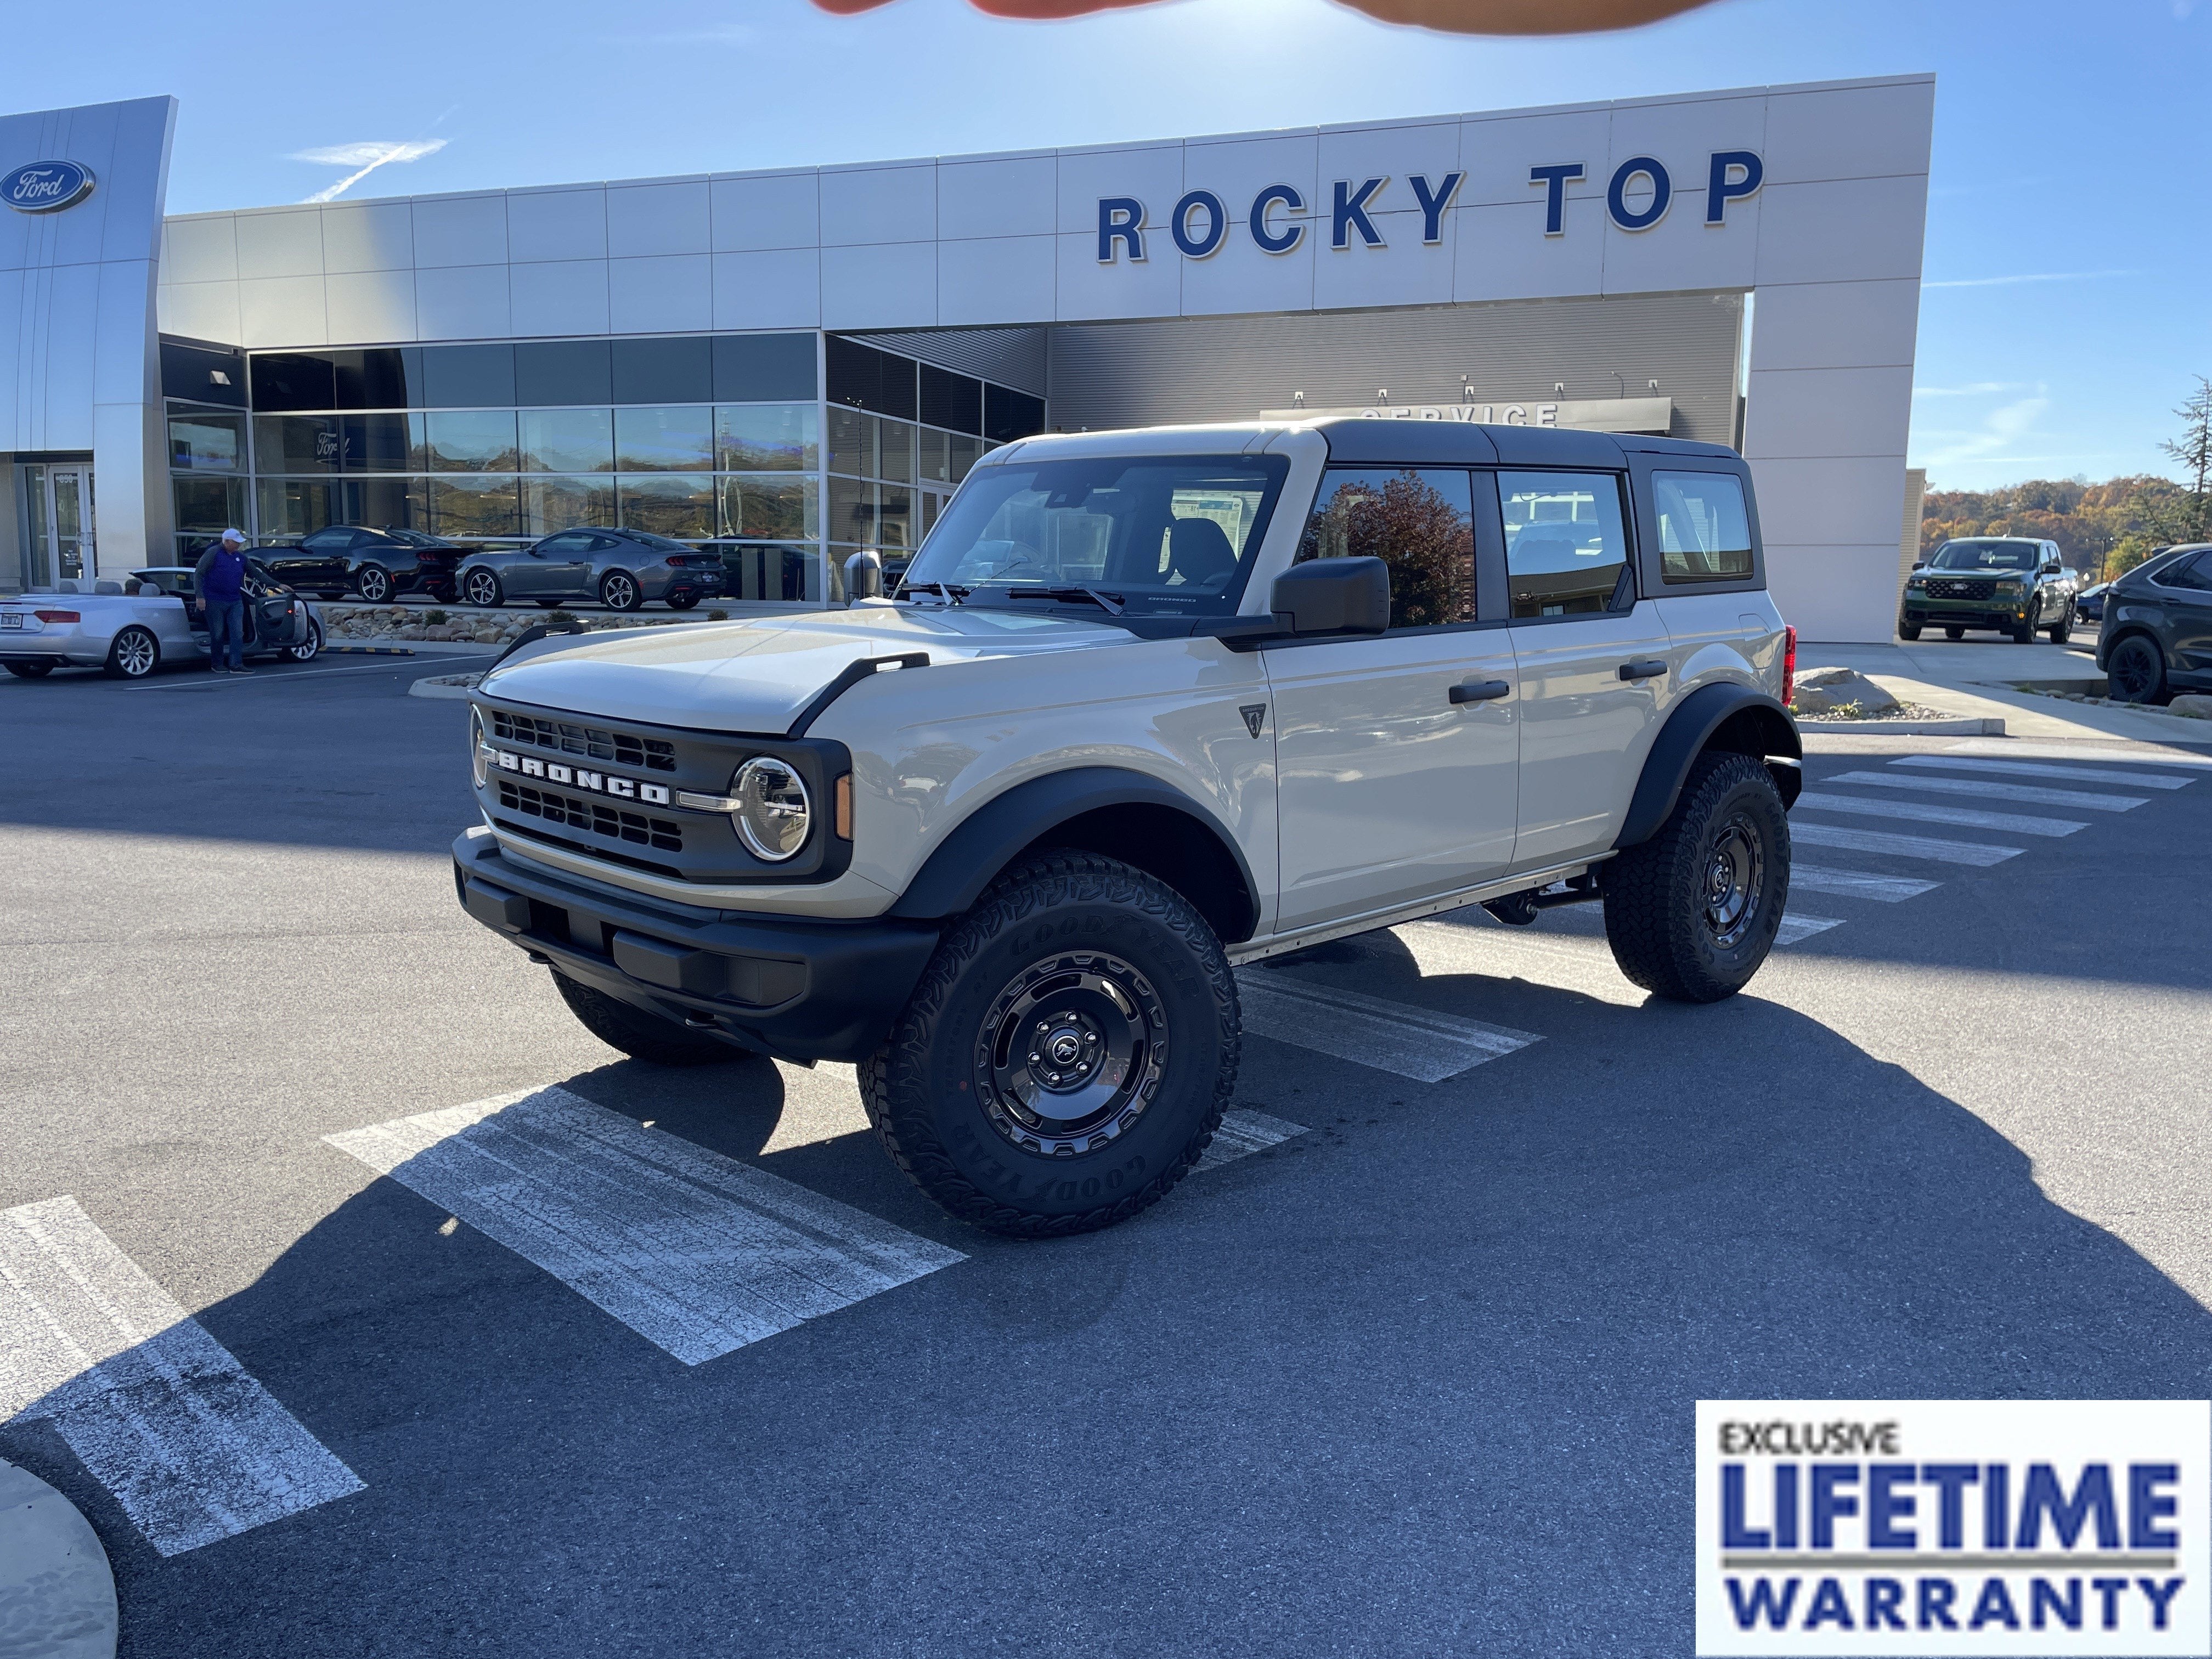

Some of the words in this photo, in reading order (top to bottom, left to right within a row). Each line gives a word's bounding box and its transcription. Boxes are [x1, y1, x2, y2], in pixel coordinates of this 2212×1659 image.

[14, 170, 65, 199] Ford
[1096, 171, 1466, 264] ROCKY
[1529, 149, 1765, 236] TOP
[499, 750, 669, 804] BRONCO
[1009, 914, 1201, 999] GOODYEAR
[951, 1122, 1147, 1205] GOODYEAR
